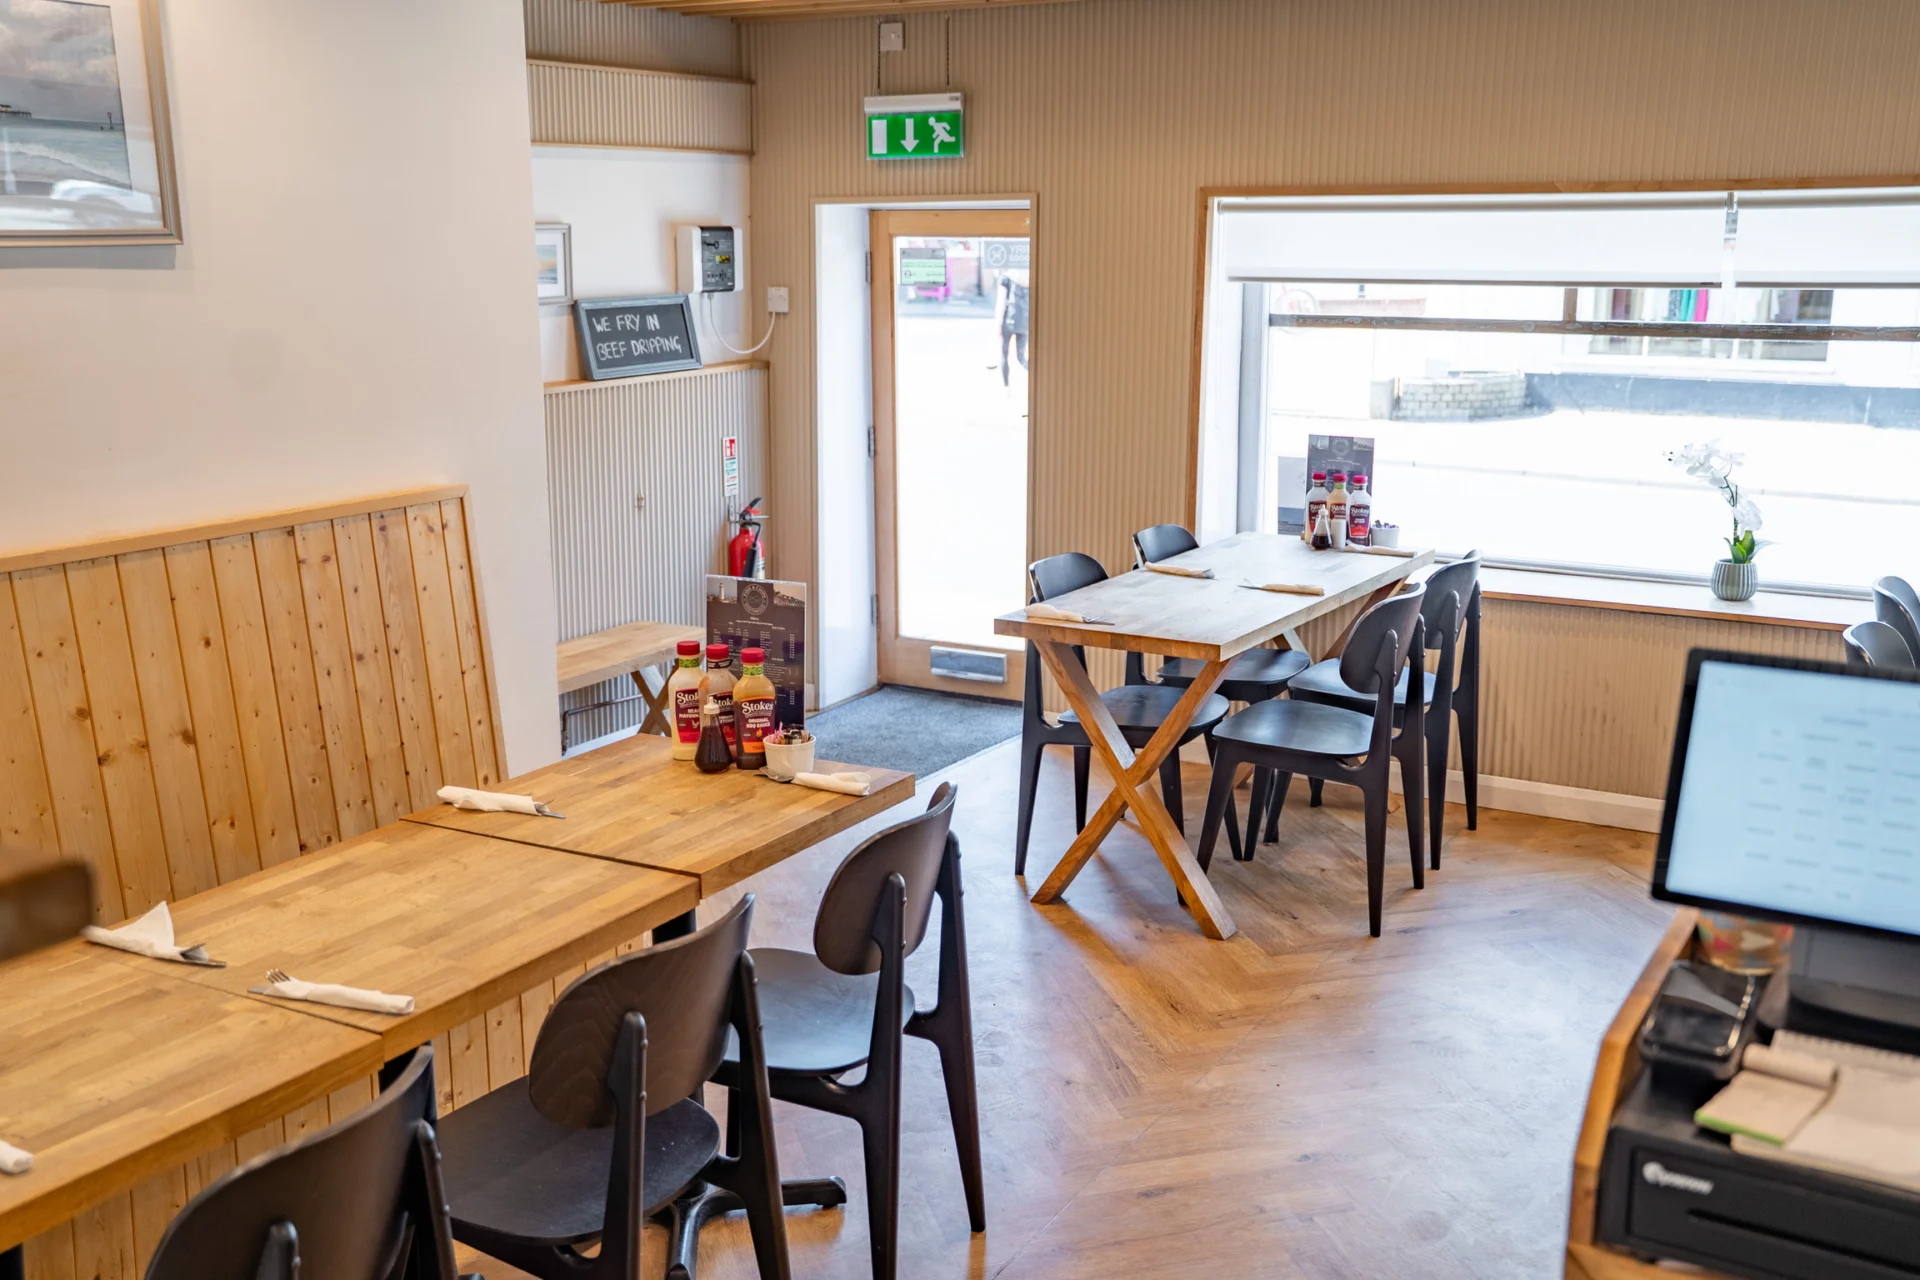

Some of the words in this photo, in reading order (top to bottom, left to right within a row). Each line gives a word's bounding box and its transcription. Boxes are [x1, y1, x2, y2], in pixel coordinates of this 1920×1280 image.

[592, 316, 612, 333] WE
[616, 314, 640, 332] FRY
[646, 313, 660, 331] IN
[596, 341, 627, 361] BEEF
[631, 335, 682, 357] DRIPPING
[676, 692, 699, 705] Stok
[741, 701, 774, 715] Stokes
